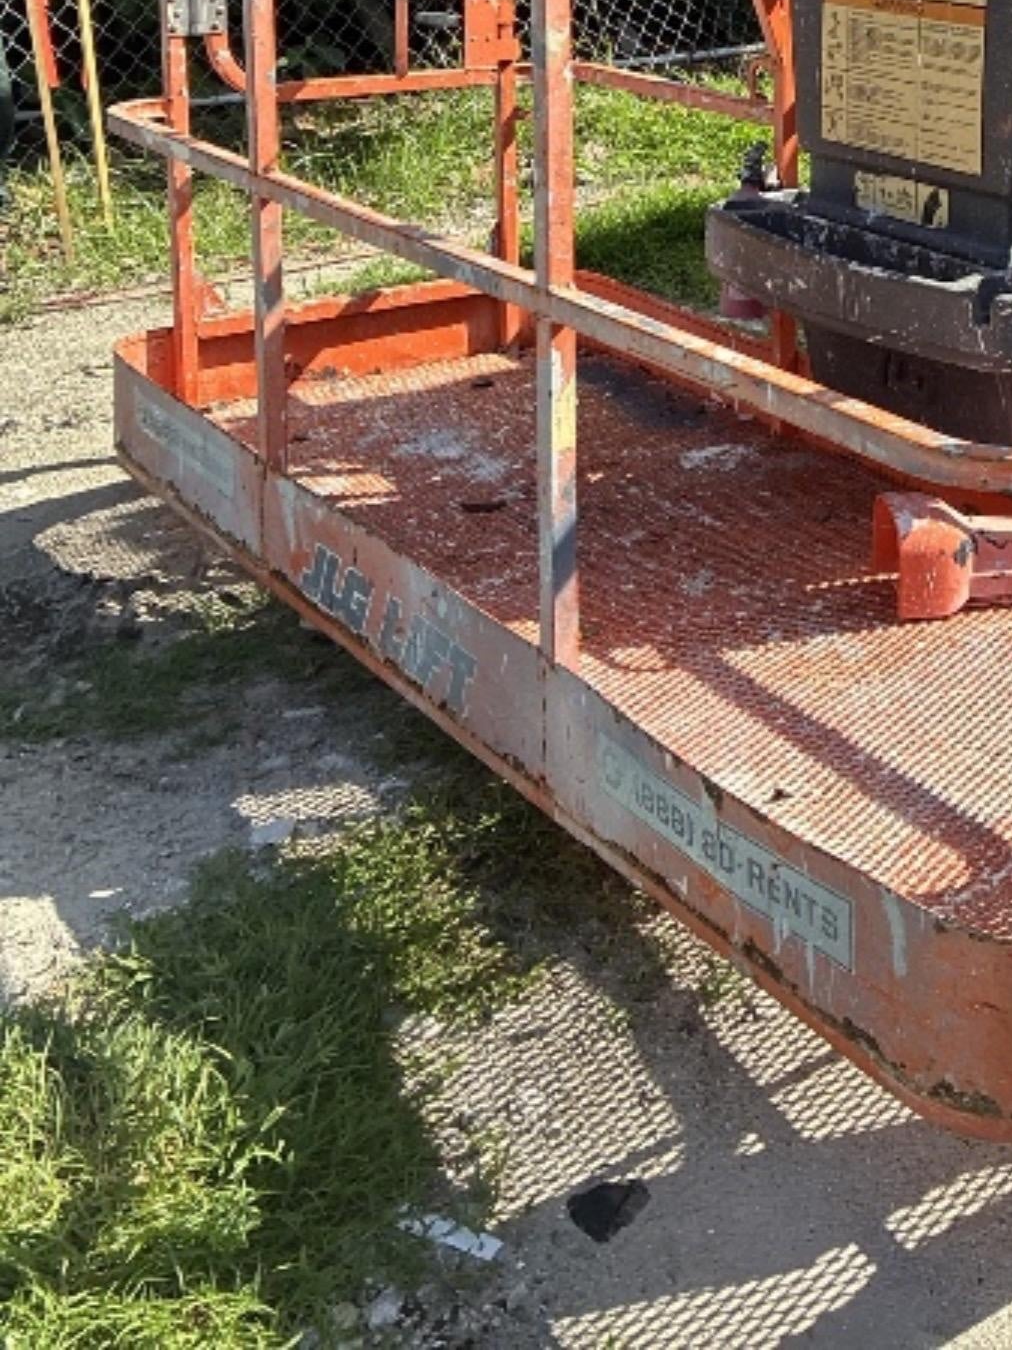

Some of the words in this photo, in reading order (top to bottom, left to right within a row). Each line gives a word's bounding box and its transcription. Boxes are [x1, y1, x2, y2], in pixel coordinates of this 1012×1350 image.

[300, 542, 375, 634] JLG
[379, 591, 479, 718] LIFT
[635, 772, 694, 846] (888)
